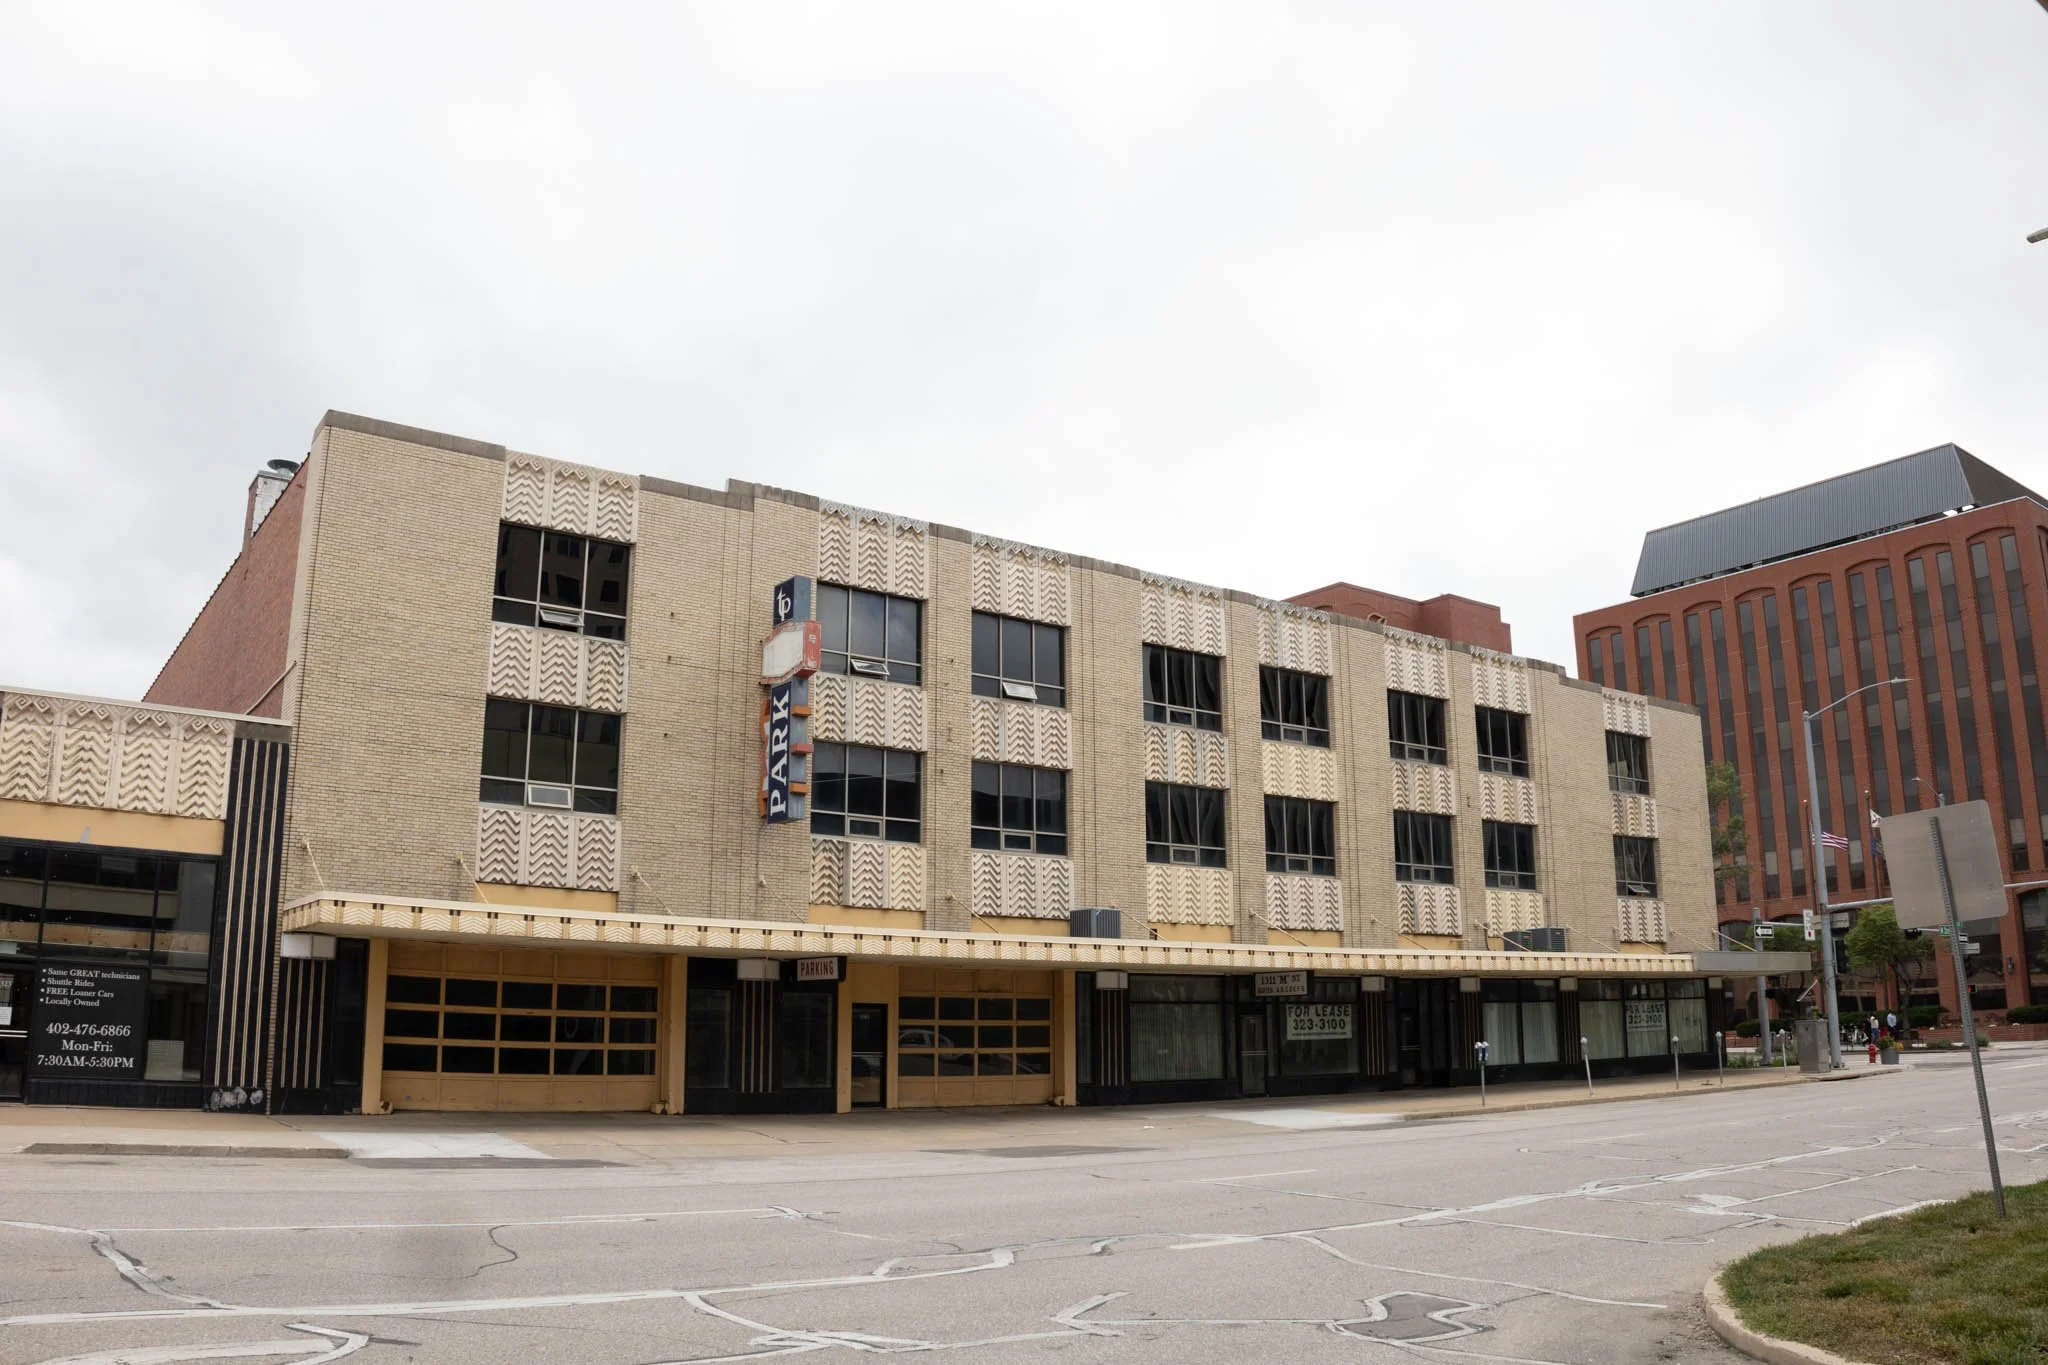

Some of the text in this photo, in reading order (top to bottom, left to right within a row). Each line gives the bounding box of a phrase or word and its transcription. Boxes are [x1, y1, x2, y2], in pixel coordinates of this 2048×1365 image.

[770, 689, 790, 816] PARK
[48, 968, 140, 980] Same GREAT technicians
[800, 960, 834, 976] PARKING
[47, 977, 95, 987] Shuttle Rides
[46, 987, 114, 998] FREE Loaner Cars
[45, 997, 100, 1007] Locally Owned
[1287, 1005, 1350, 1017] FOR LEASE
[46, 1022, 131, 1037] 402-476-6866
[1293, 1018, 1346, 1030] 323-3100
[61, 1039, 113, 1052] Mon-Fri:
[37, 1054, 135, 1068] 7:30AM-5:30PM
